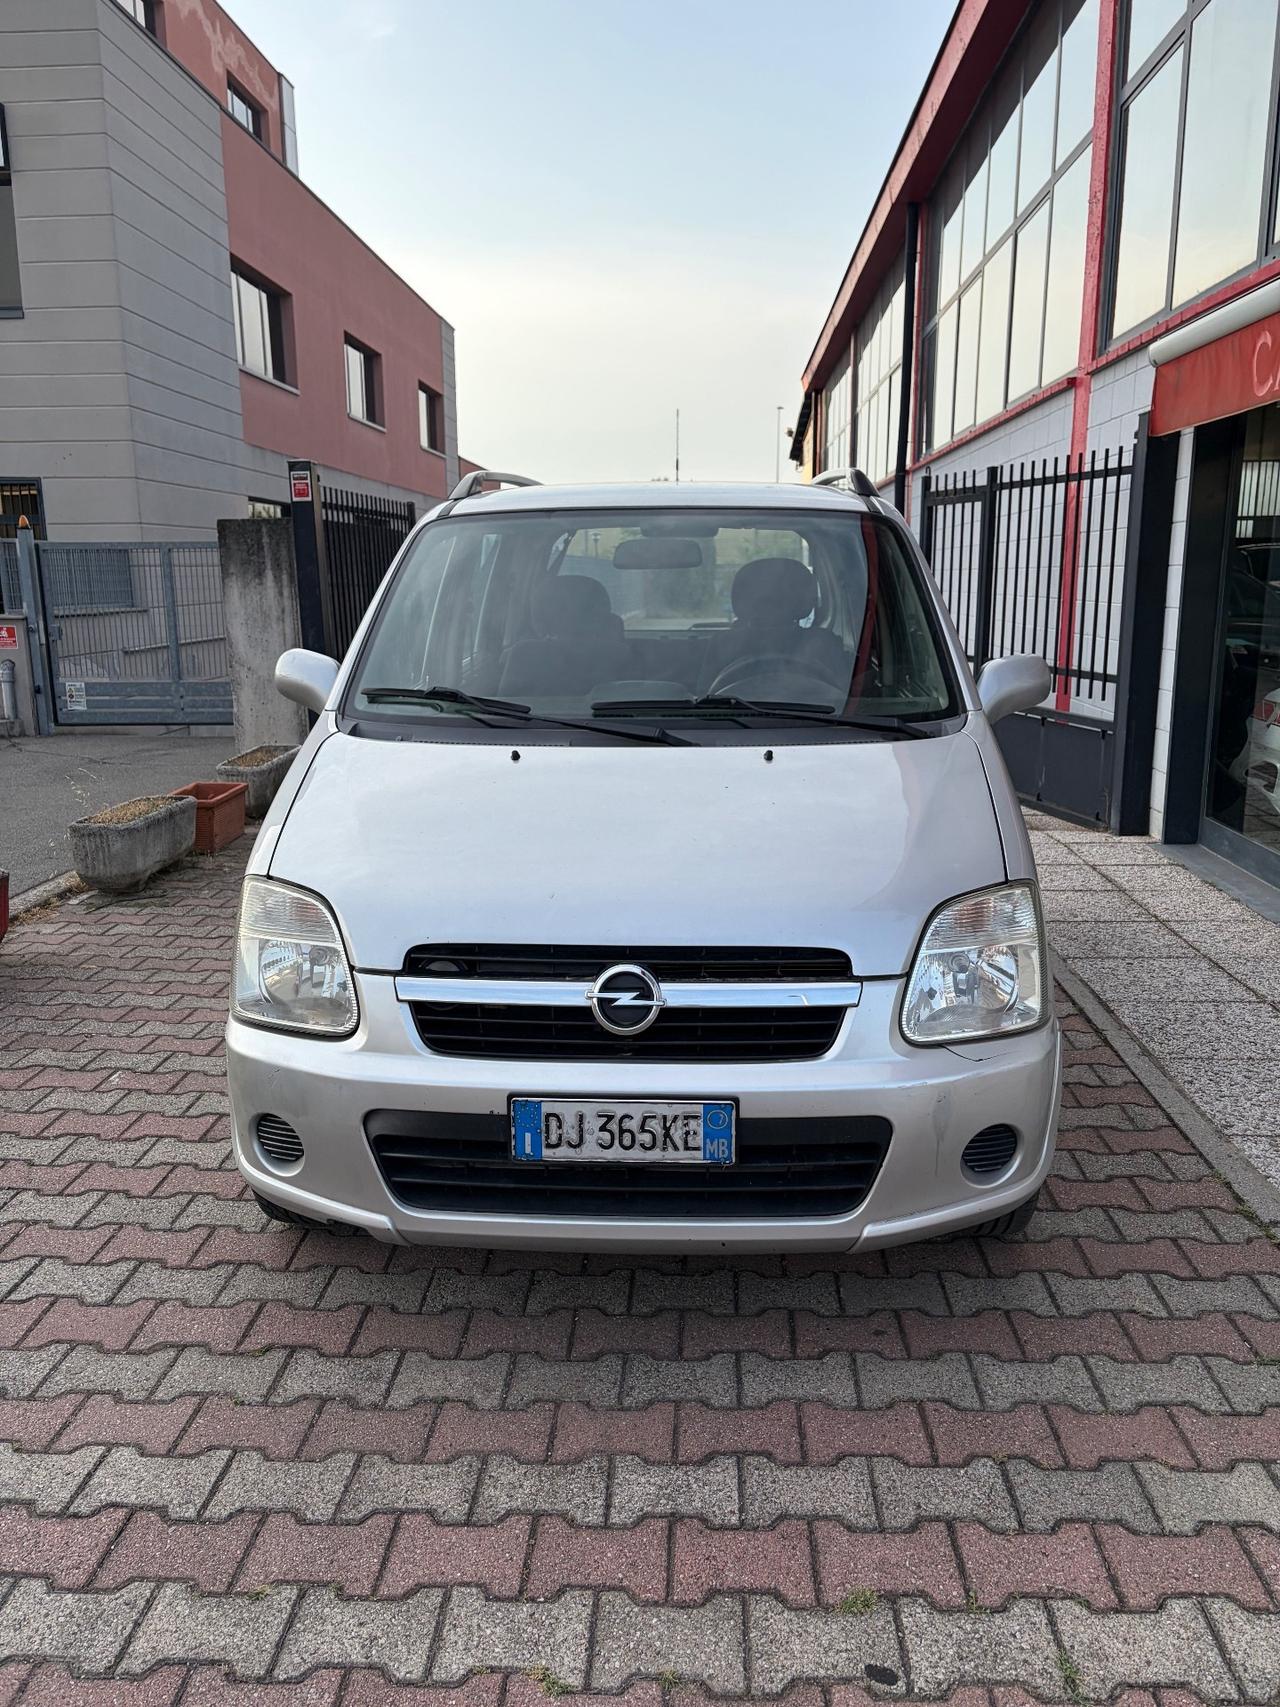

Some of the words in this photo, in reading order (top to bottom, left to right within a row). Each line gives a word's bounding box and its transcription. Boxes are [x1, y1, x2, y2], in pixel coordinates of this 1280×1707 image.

[544, 1112, 584, 1149] DJ
[597, 1112, 702, 1151] 365KE
[706, 1138, 729, 1159] MB
